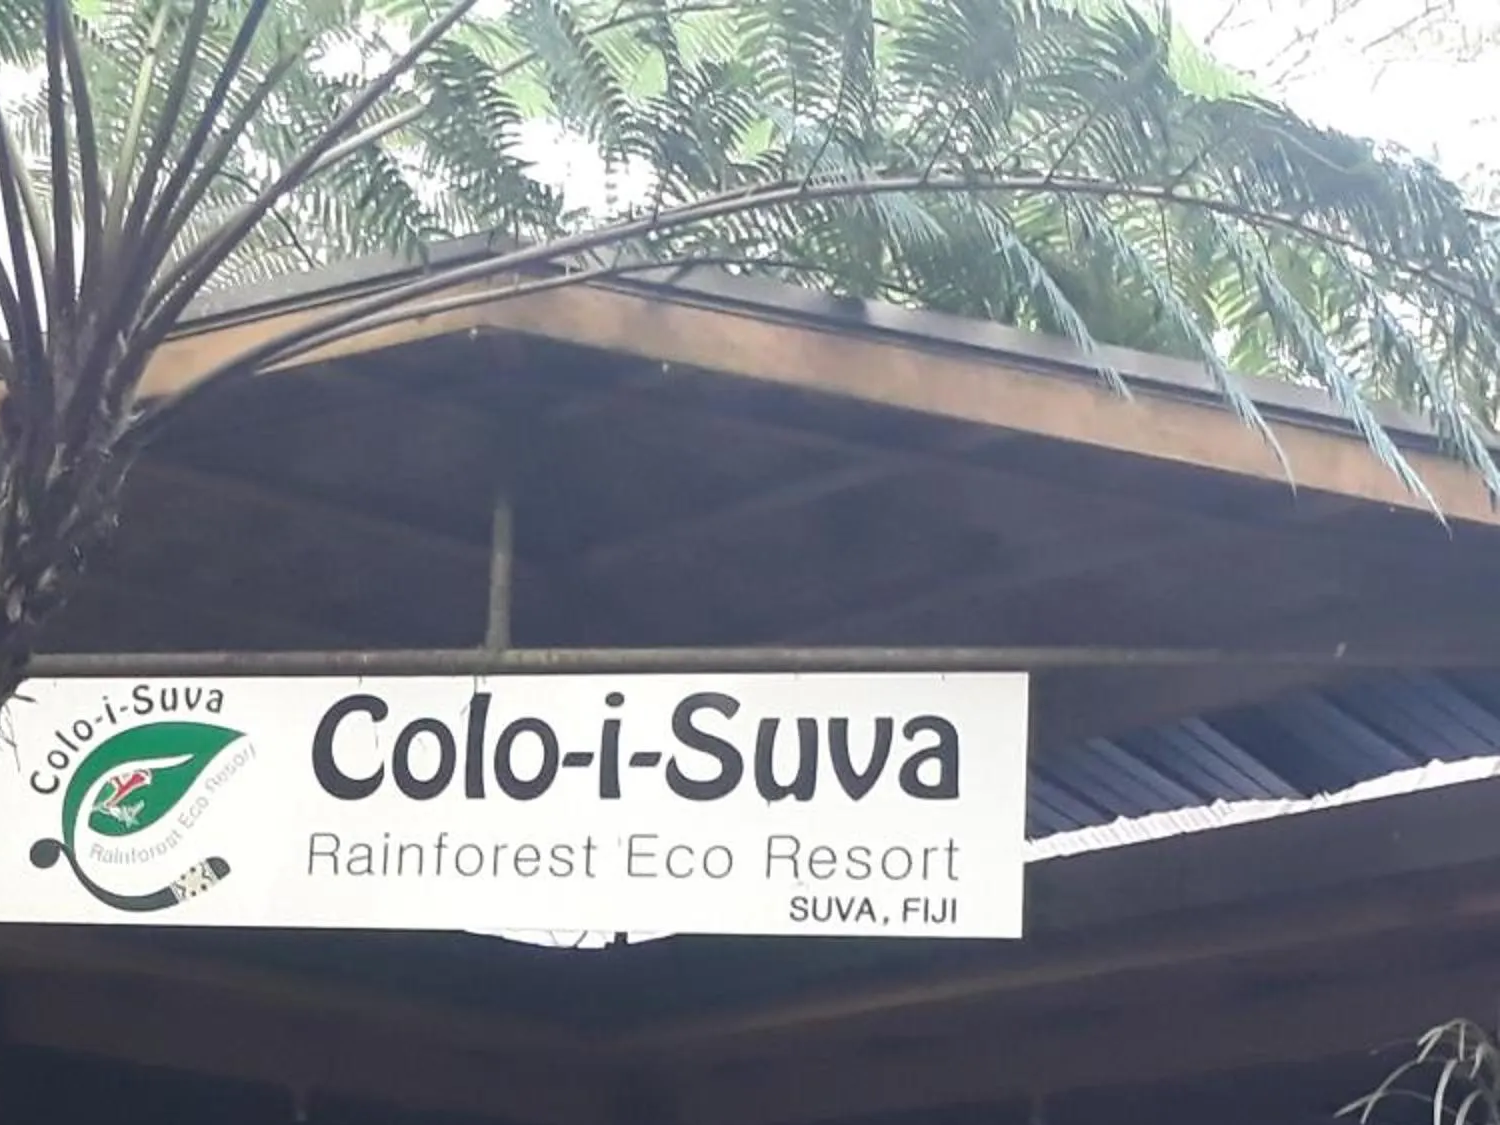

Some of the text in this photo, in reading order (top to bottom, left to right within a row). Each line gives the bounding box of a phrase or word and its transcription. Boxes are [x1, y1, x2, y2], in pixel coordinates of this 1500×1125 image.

[30, 684, 224, 795] Colo-i-Suva
[311, 691, 960, 802] Colo-i-Suva
[178, 795, 210, 829] Eco
[307, 832, 960, 881] Rainforest Eco Resort
[789, 896, 957, 925] SUVA, FIJI
